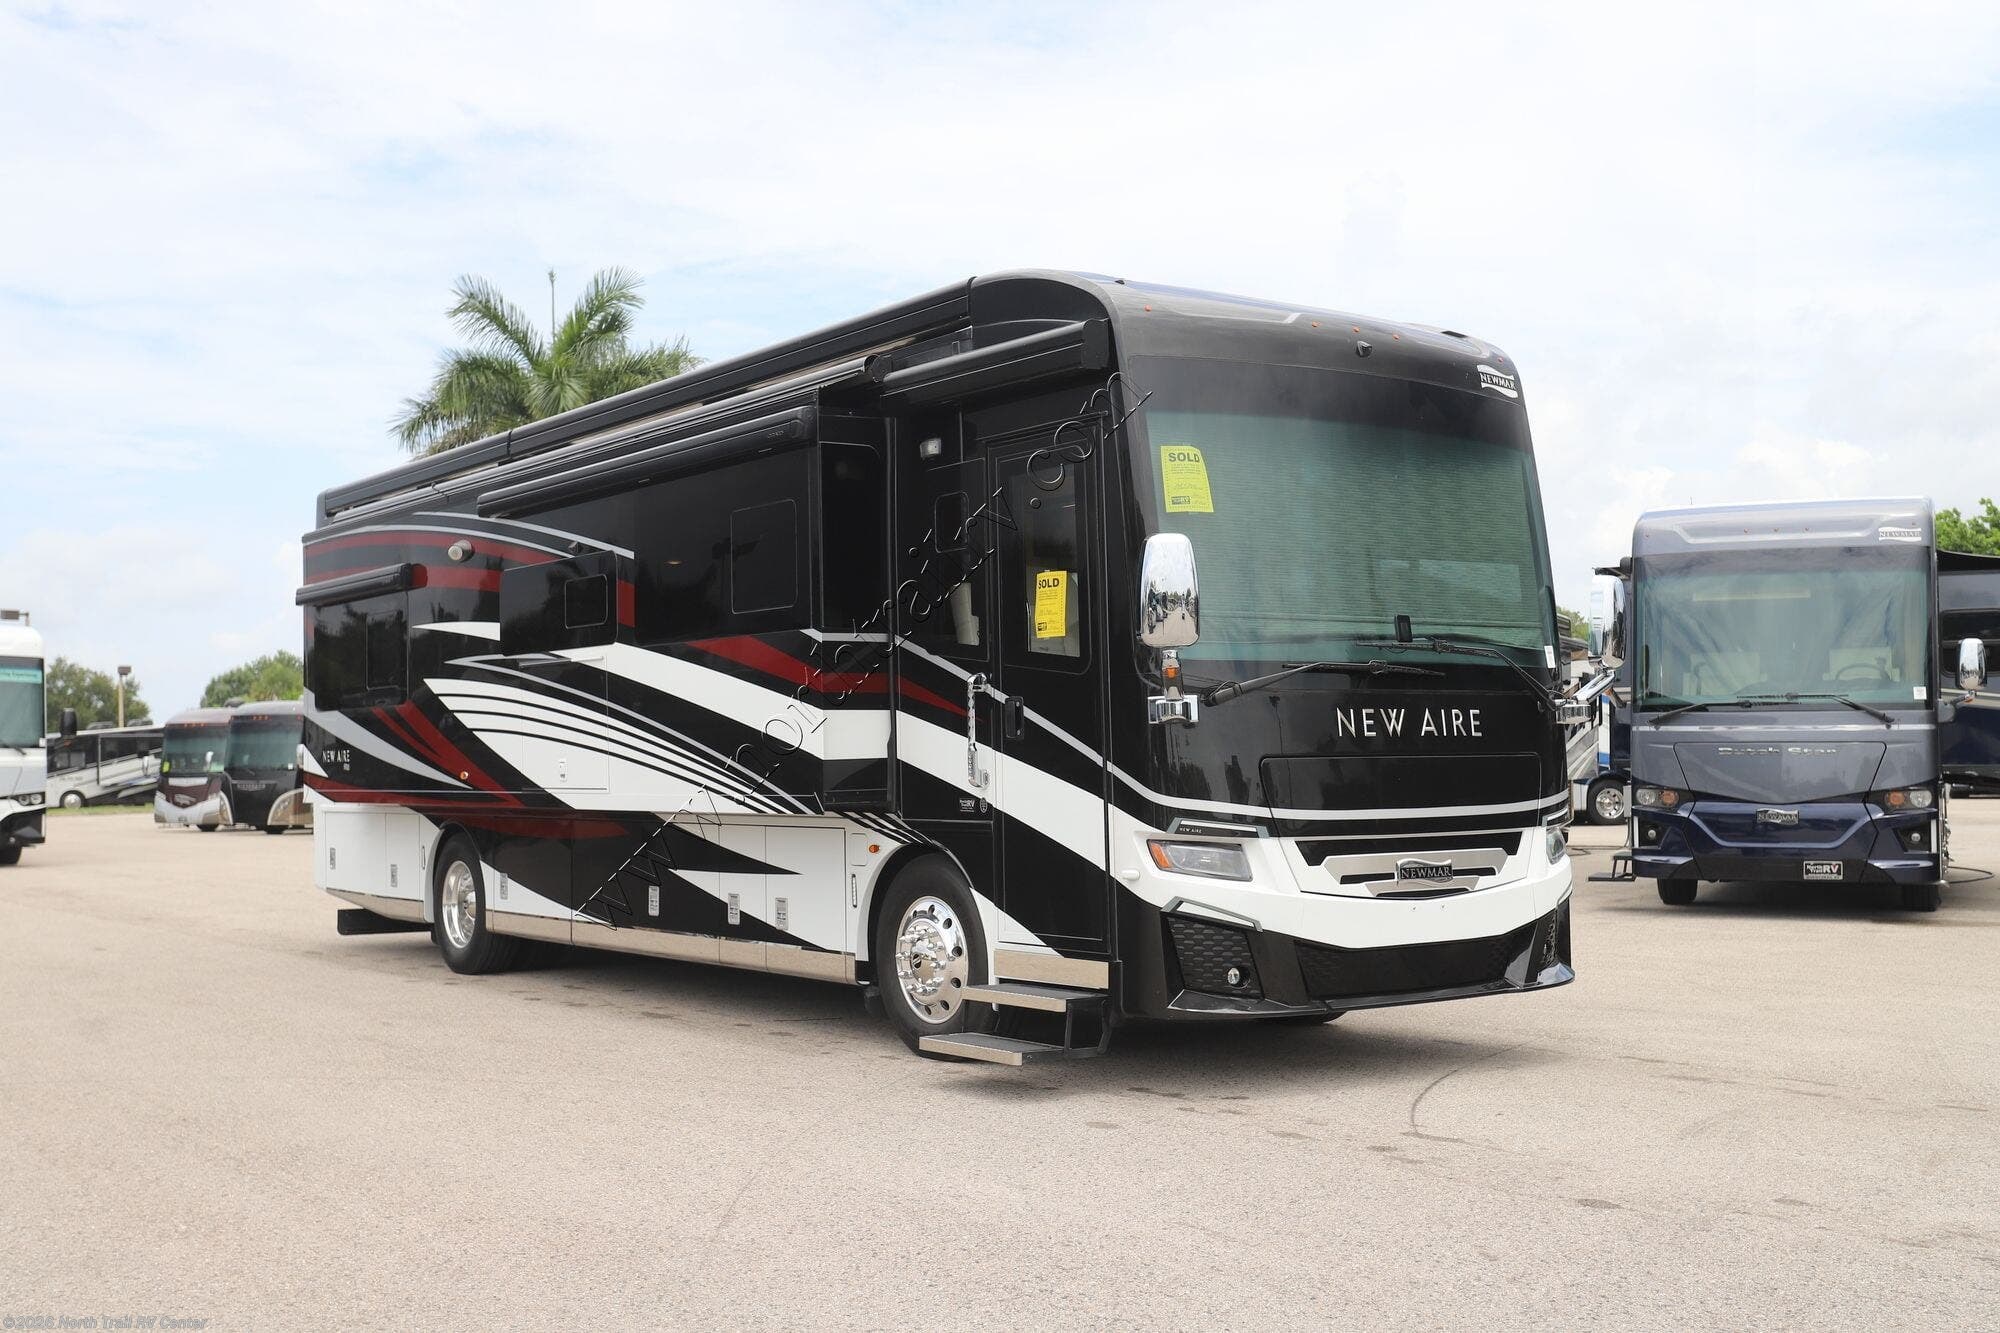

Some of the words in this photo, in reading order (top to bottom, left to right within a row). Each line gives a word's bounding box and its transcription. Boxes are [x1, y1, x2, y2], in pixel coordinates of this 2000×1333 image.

[1480, 372, 1516, 390] NEWMAR
[1168, 452, 1200, 463] SOLD
[1038, 578, 1060, 589] SOLD
[1336, 707, 1405, 738] NEW
[1421, 707, 1483, 737] AIRE
[322, 750, 336, 763] NEW
[337, 750, 350, 762] AIRE
[1401, 866, 1452, 879] NEWMAR
